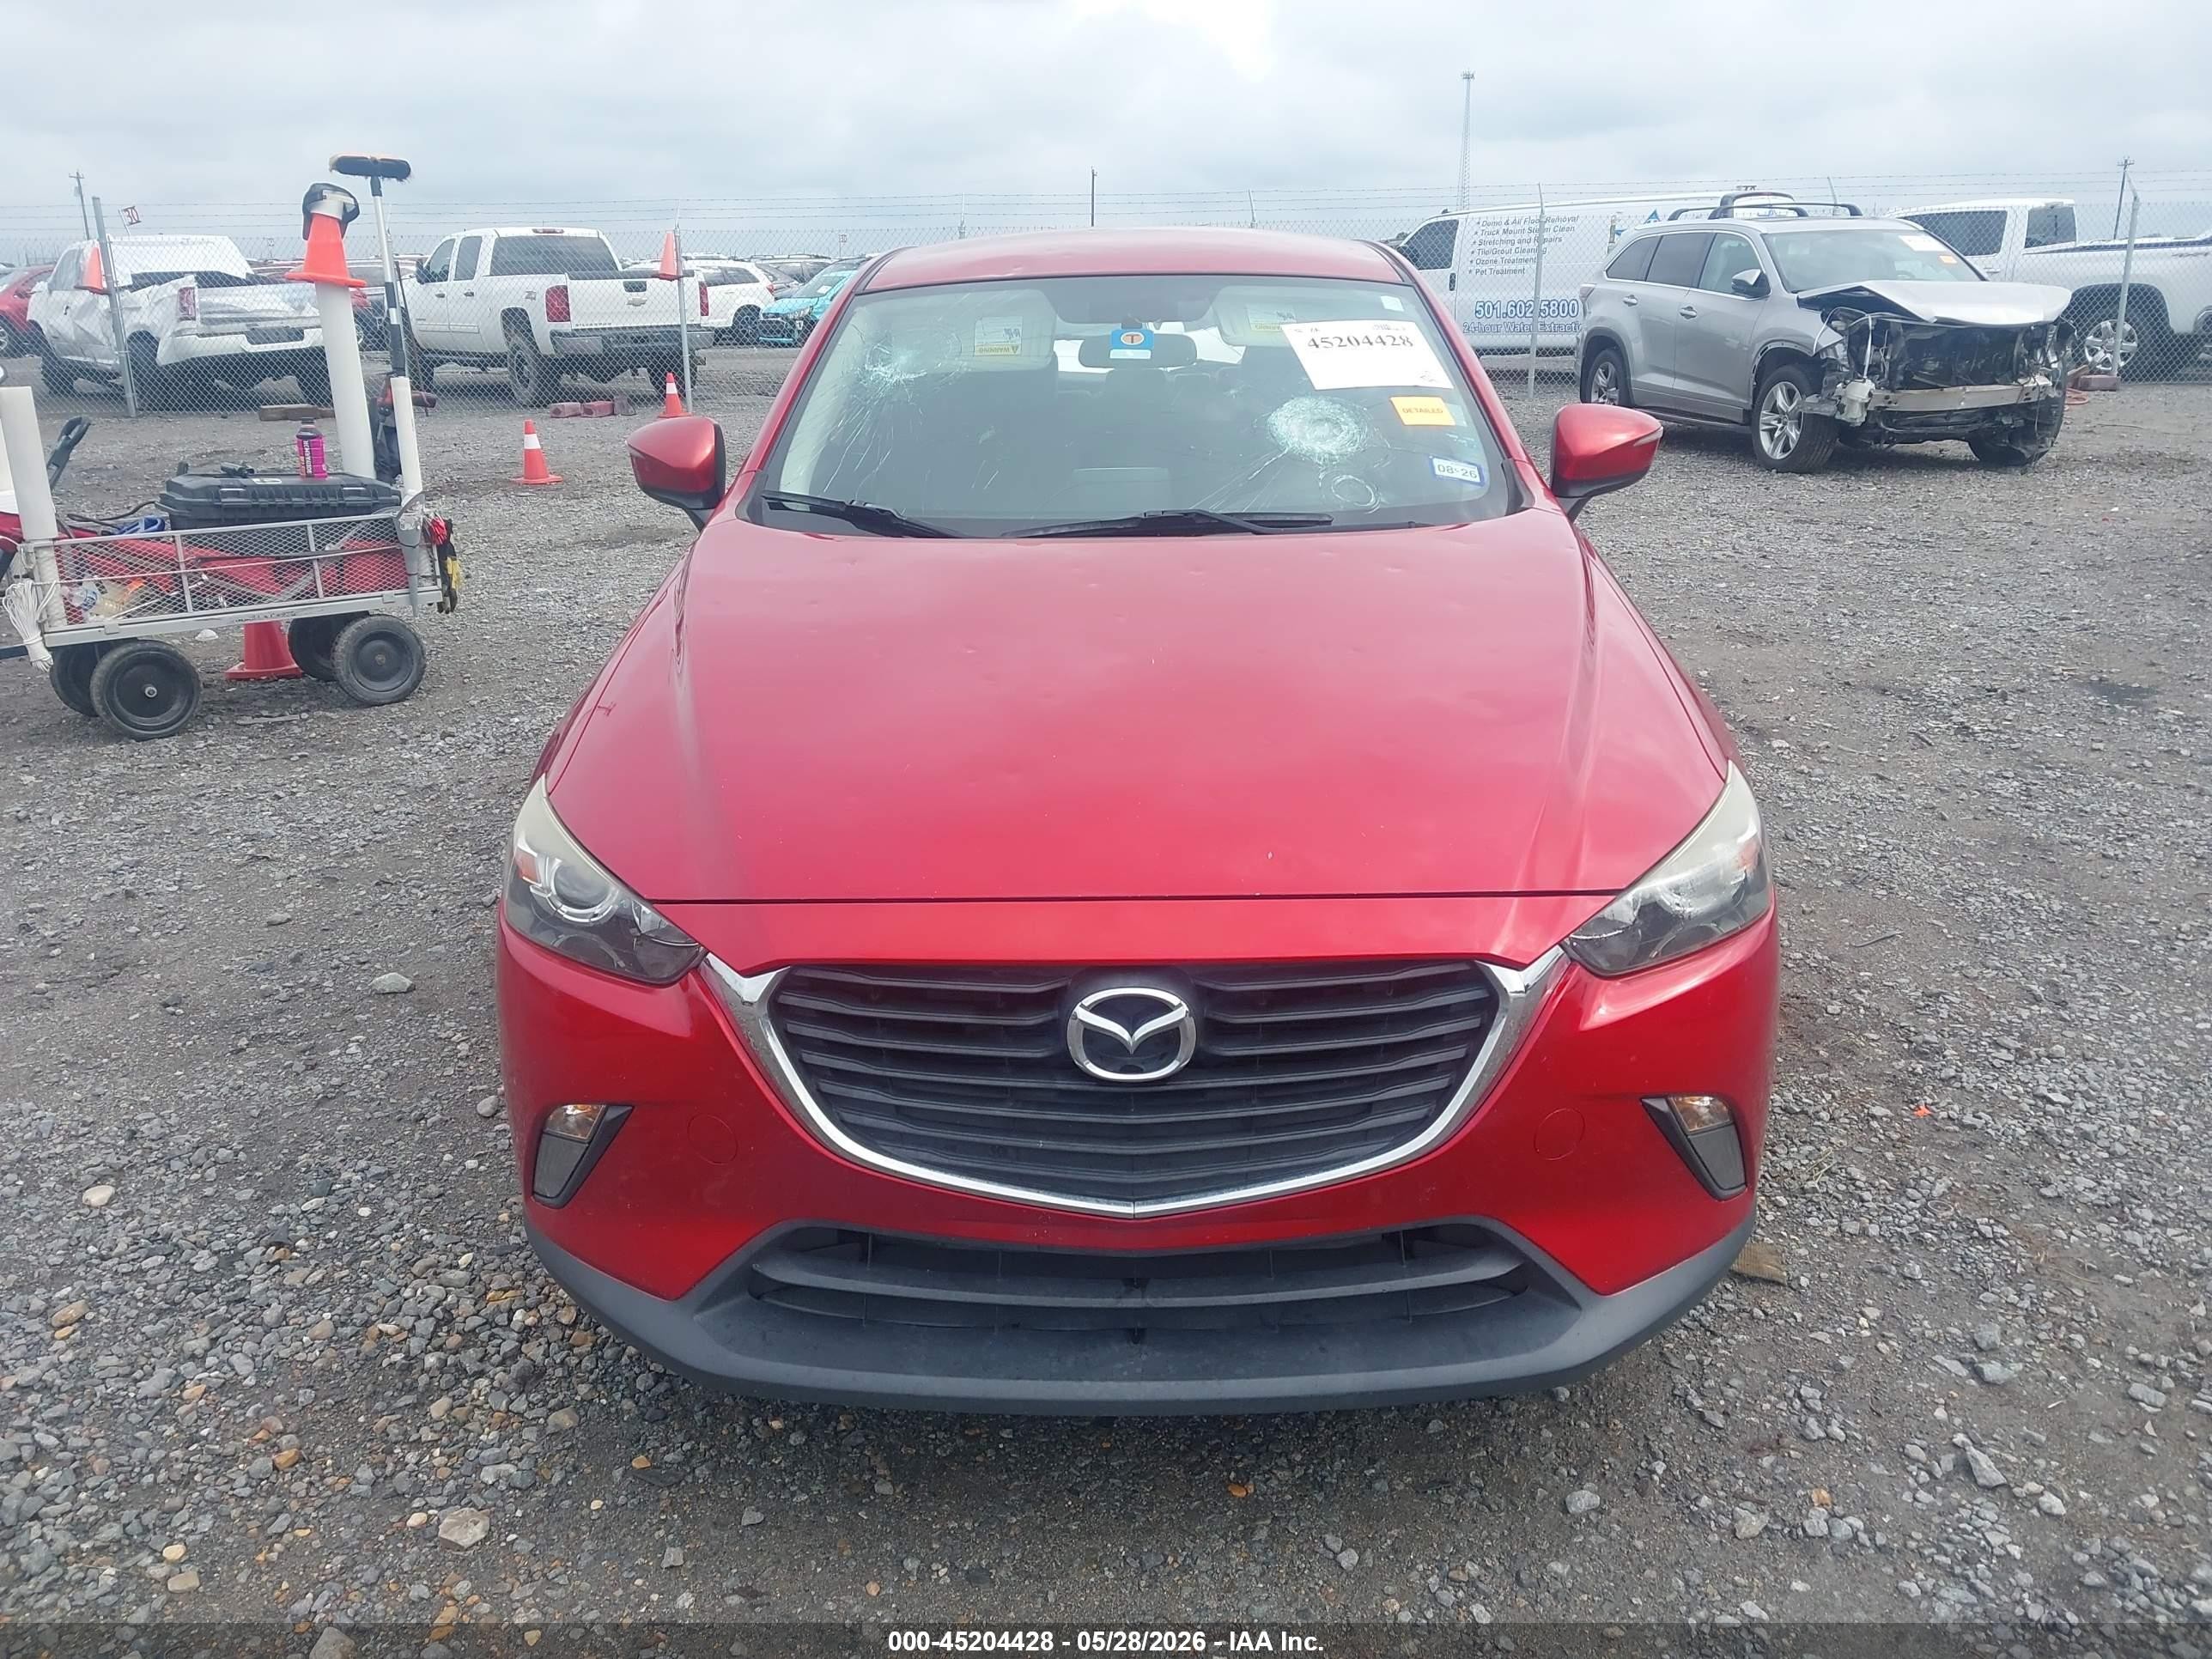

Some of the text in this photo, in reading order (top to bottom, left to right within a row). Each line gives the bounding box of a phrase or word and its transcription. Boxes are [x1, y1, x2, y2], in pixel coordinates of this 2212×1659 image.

[1523, 216, 1541, 225] Floo
[1546, 215, 1579, 223] Removal
[1478, 238, 1515, 246] Stretching
[1534, 236, 1563, 245] Rpairs
[1514, 246, 1547, 255] Cleanig
[1474, 299, 1579, 319] 501.6025800
[1462, 321, 1502, 333] 24-hour
[1538, 320, 1581, 333] Extracti
[1307, 334, 1414, 349] 45204428
